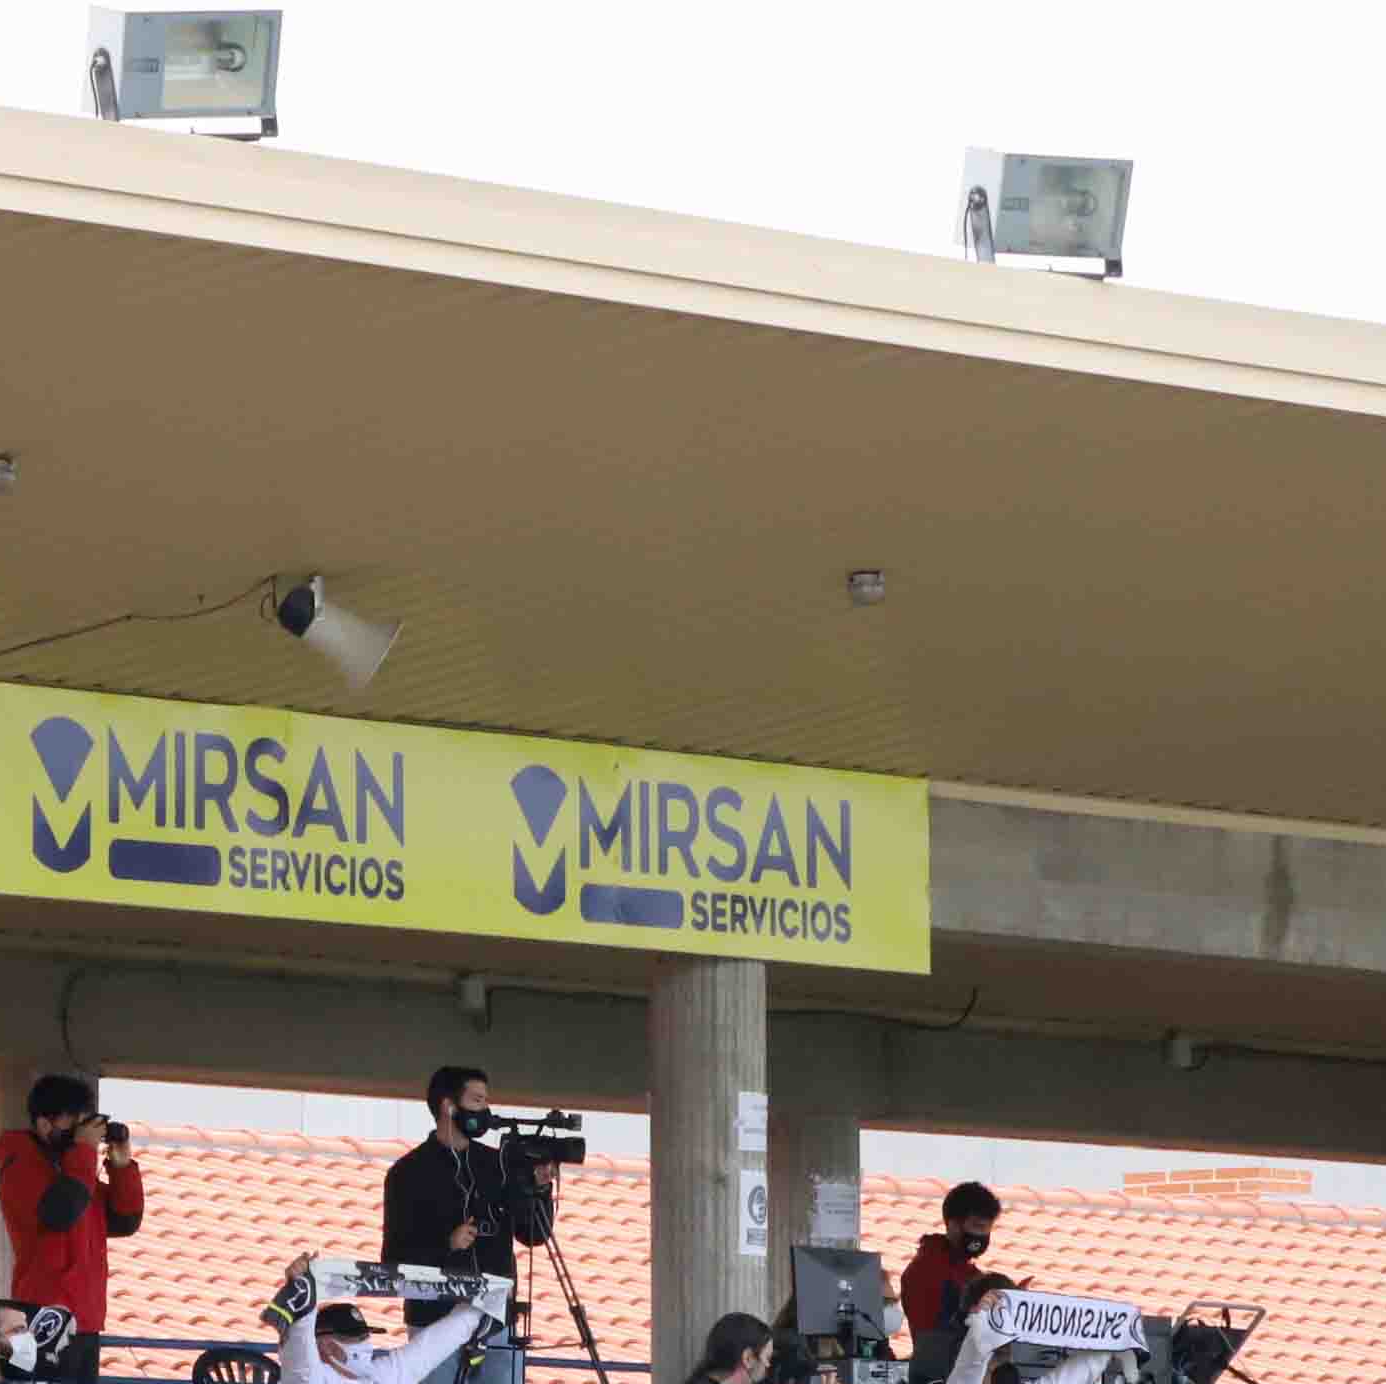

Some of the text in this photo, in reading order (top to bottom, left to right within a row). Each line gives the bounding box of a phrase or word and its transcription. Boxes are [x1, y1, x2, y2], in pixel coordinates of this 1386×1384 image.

[107, 723, 405, 845] MIRSAN
[227, 844, 405, 901] SERVICIOS
[578, 775, 852, 893] MIRSAN
[689, 890, 852, 944] SERVICIOS
